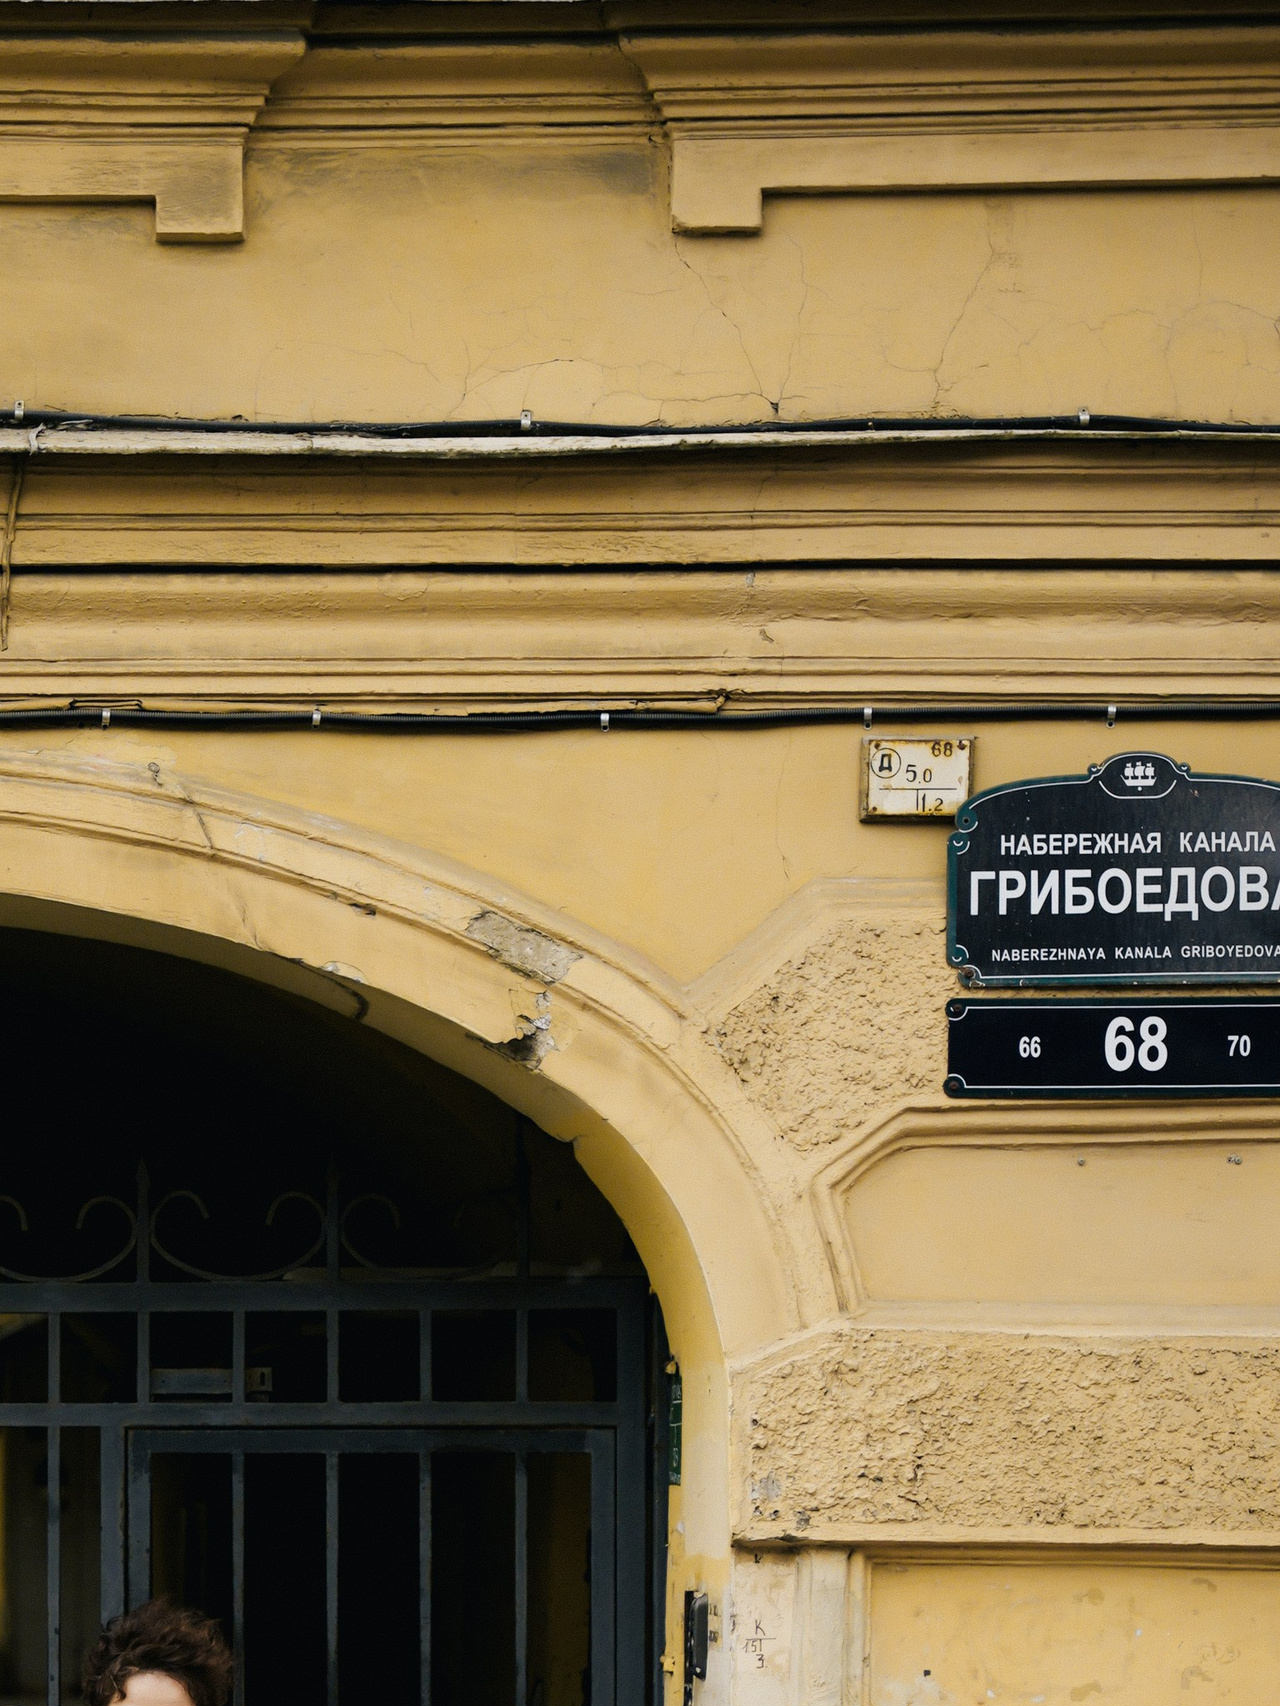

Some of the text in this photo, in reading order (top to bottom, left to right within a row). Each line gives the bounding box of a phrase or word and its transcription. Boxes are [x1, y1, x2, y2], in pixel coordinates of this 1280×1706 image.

[878, 753, 892, 772] Д
[905, 764, 932, 784] 5.0
[1000, 831, 1277, 856] НАБЕРЕЖНАЯ КАНАЛА
[970, 865, 1280, 922] ГРИБОЕДОВ
[991, 948, 1106, 962] NABEREZHNAYA
[1114, 945, 1172, 960] KANALA
[1018, 1015, 1251, 1072] 66 68 70
